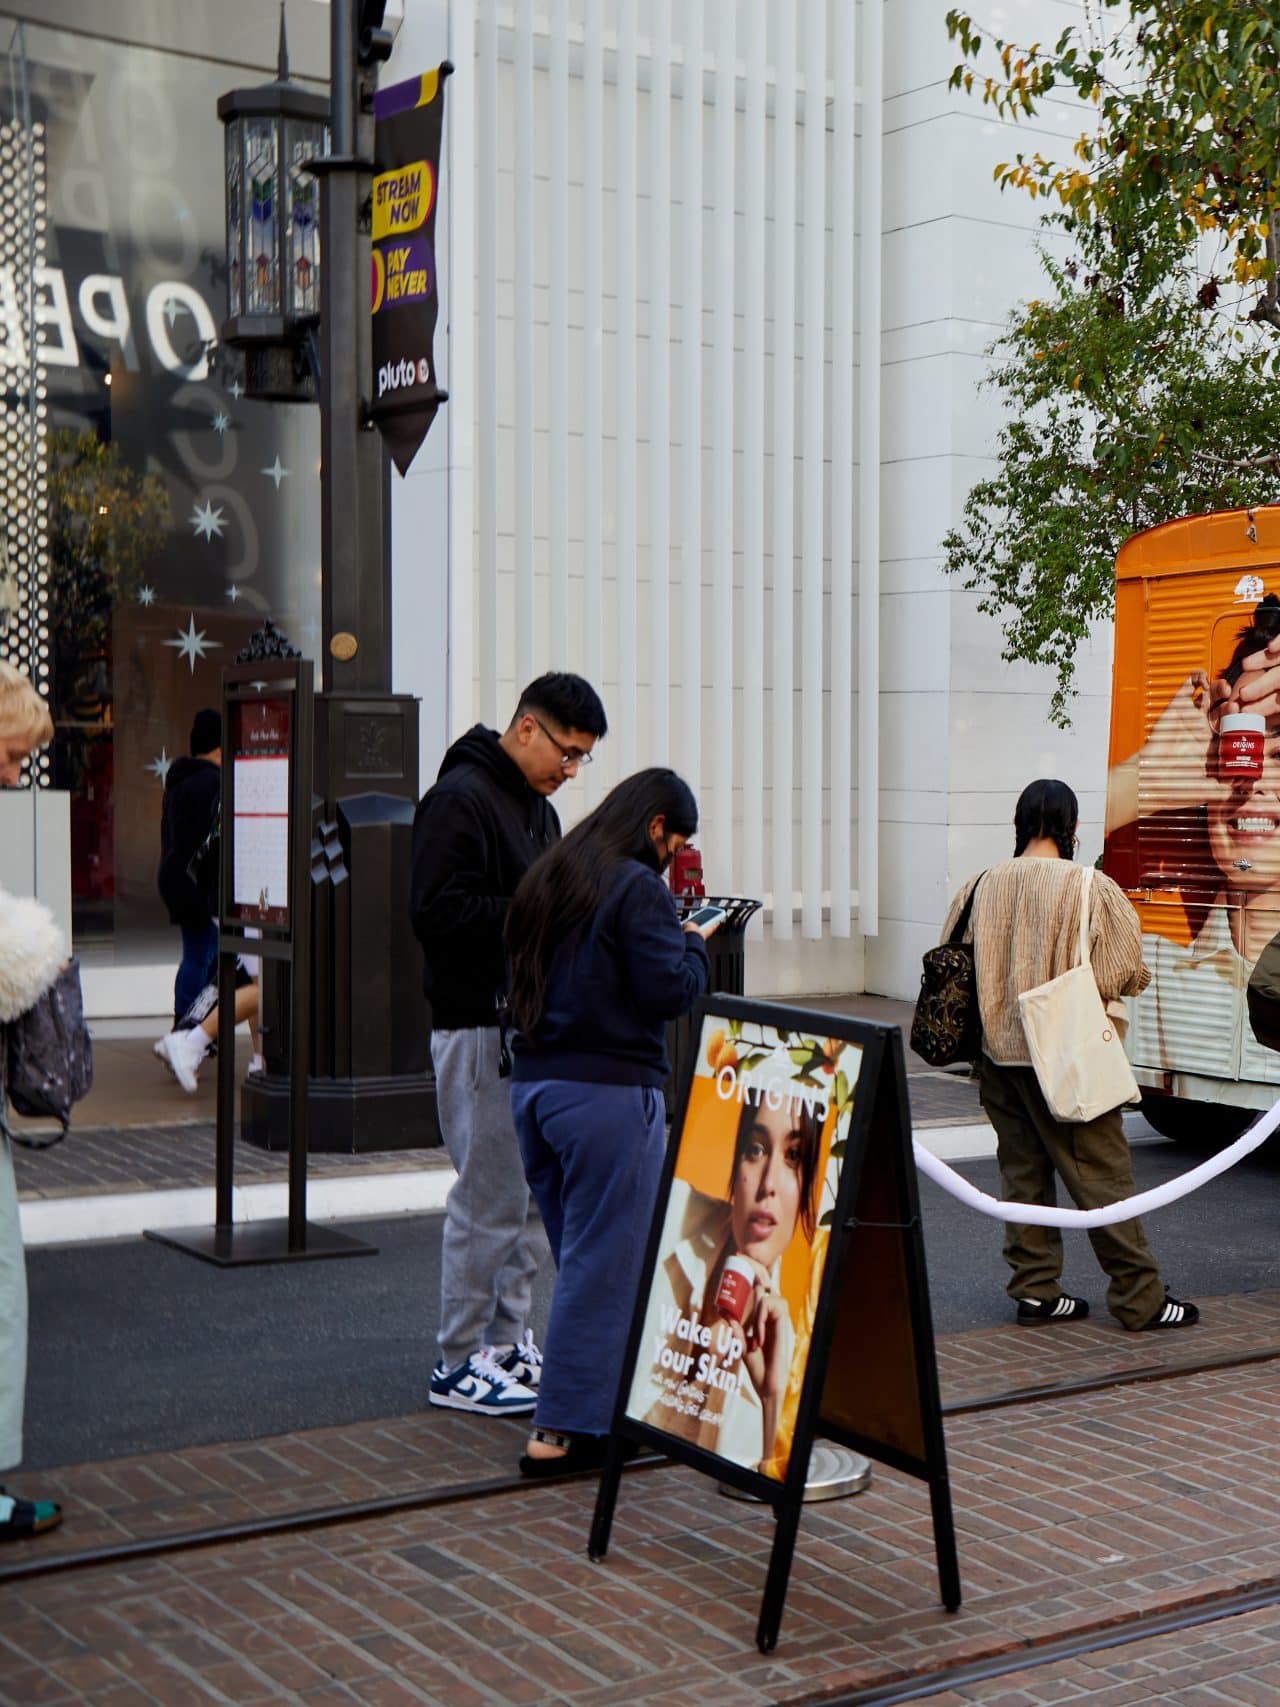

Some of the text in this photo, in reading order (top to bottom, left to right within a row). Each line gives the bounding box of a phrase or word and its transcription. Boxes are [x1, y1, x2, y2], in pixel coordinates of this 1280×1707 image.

[376, 170, 422, 206] STREAM
[389, 196, 420, 226] NOW
[387, 247, 412, 275] PAY
[387, 269, 428, 301] NEVER
[378, 357, 416, 398] pluto
[716, 1065, 830, 1122] ORIGINS
[660, 1303, 743, 1367] Wake Up
[654, 1335, 695, 1376] Your
[695, 1353, 743, 1397] Skin!
